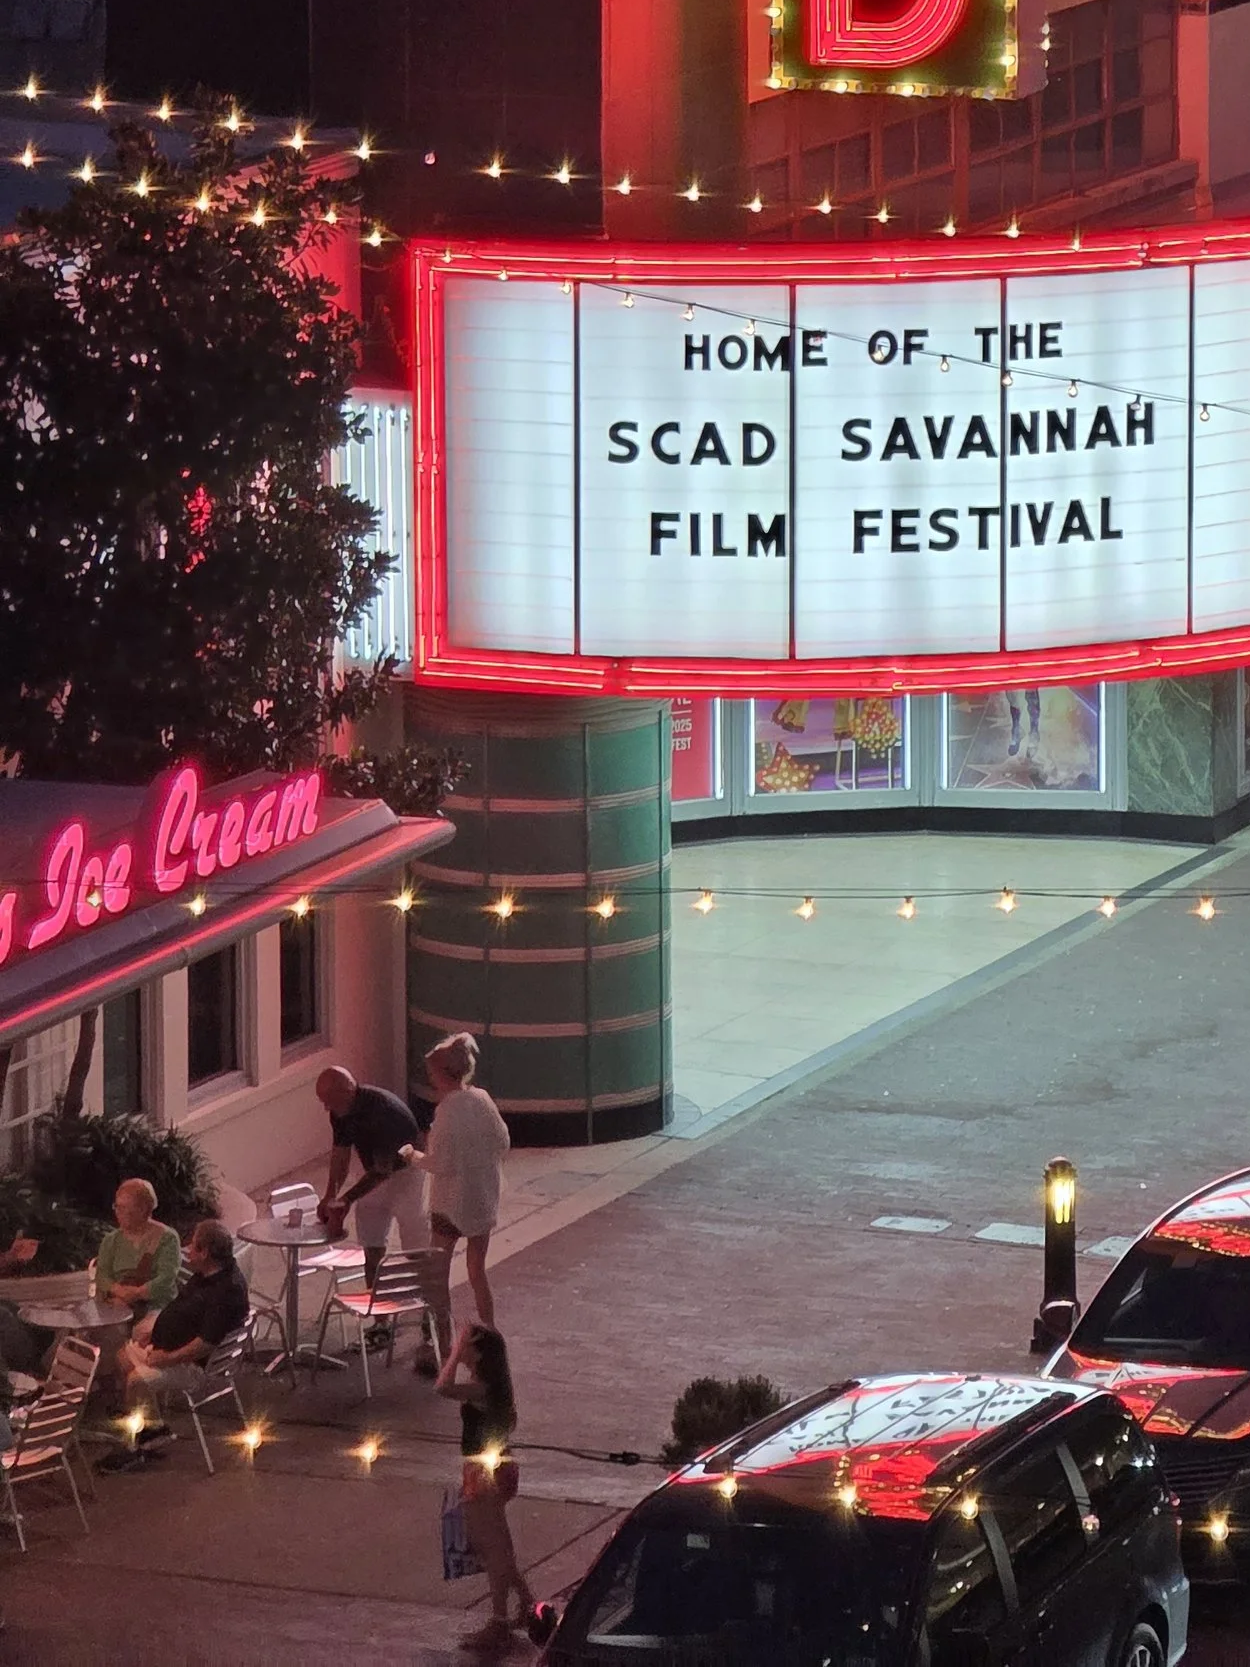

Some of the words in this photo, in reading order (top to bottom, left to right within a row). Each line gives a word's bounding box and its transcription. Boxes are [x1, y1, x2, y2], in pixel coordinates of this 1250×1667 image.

[684, 331, 828, 371] HOME
[867, 328, 930, 366] OF
[974, 321, 1064, 362] THE
[608, 422, 776, 465] SCAD
[840, 402, 1155, 462] SAVANNAH
[649, 512, 787, 556] FILM
[853, 496, 1123, 555] FESTIVAL
[27, 823, 132, 950] Ice
[154, 768, 321, 892] Cream
